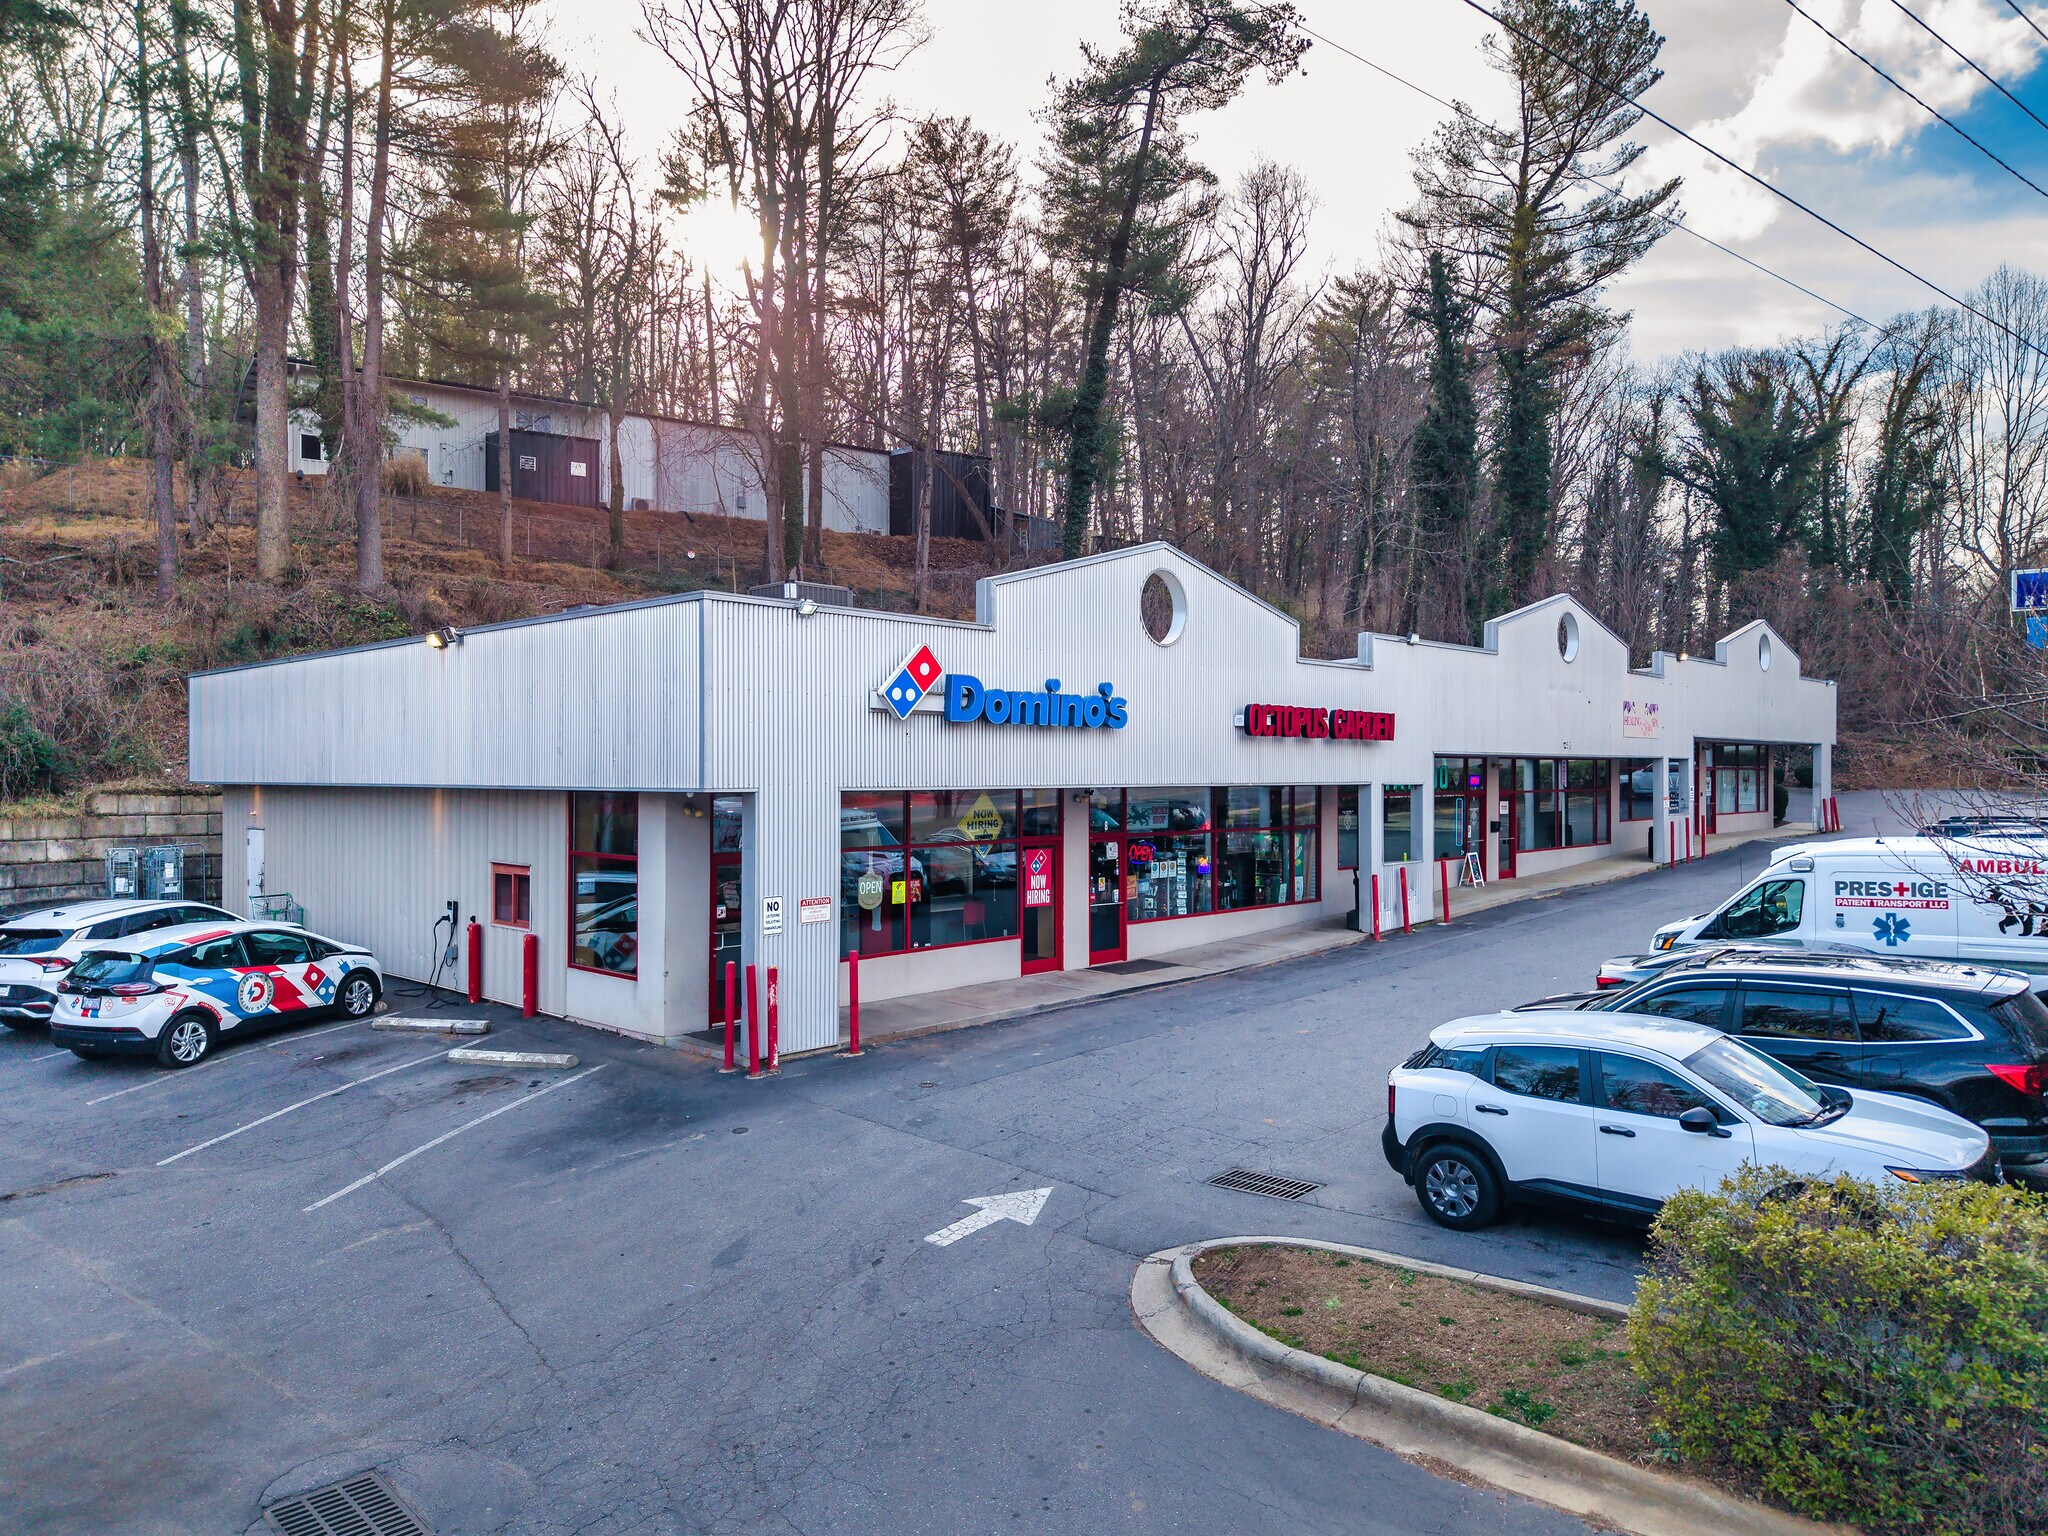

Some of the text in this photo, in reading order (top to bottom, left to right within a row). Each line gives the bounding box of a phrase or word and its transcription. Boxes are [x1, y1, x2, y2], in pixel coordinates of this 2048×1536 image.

[944, 673, 1128, 730] Domino's
[1246, 703, 1396, 742] OCTOPUS GARDEN
[973, 808, 994, 819] NOW
[1153, 815, 1166, 825] SHOP
[966, 820, 998, 830] HIRING
[1129, 844, 1154, 862] OPEN
[1959, 858, 2048, 875] AMBUL
[859, 880, 882, 895] OPEN
[1031, 875, 1047, 890] NOW
[801, 898, 830, 907] ATTENTION
[1026, 889, 1050, 905] HIRING
[1836, 898, 1947, 909] PATIENT TRANSPORT LLC
[766, 901, 780, 912] NO
